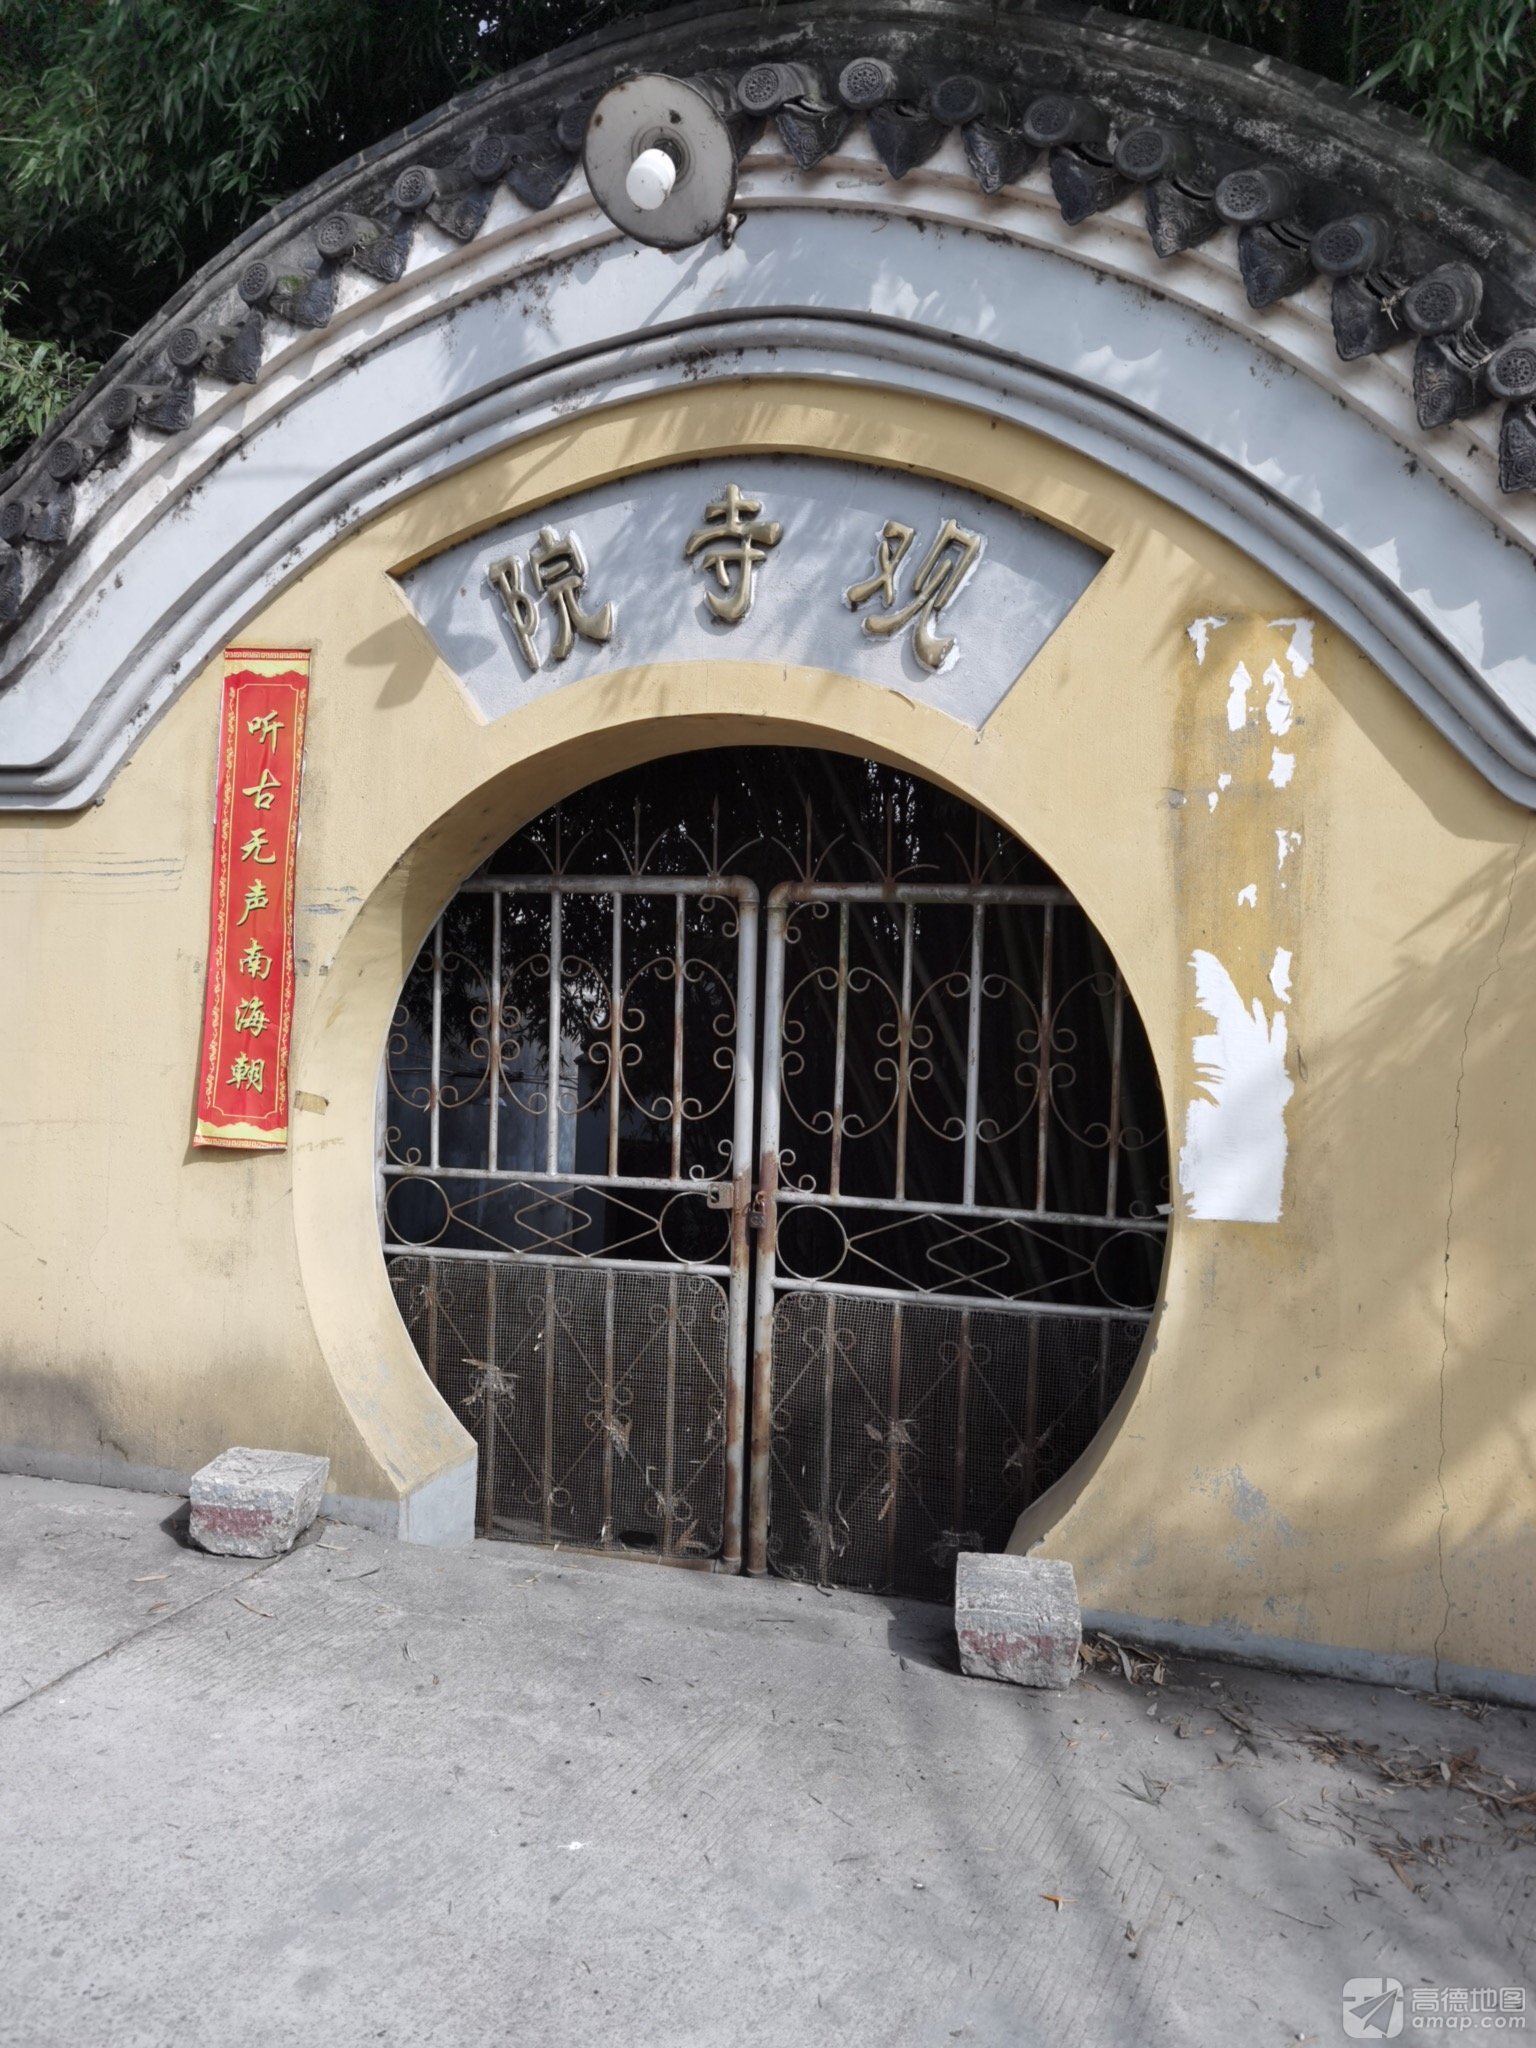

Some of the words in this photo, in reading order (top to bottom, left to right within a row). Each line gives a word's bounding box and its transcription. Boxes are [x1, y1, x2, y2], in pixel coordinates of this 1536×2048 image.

[226, 709, 285, 1095] 听古无声南海朝
